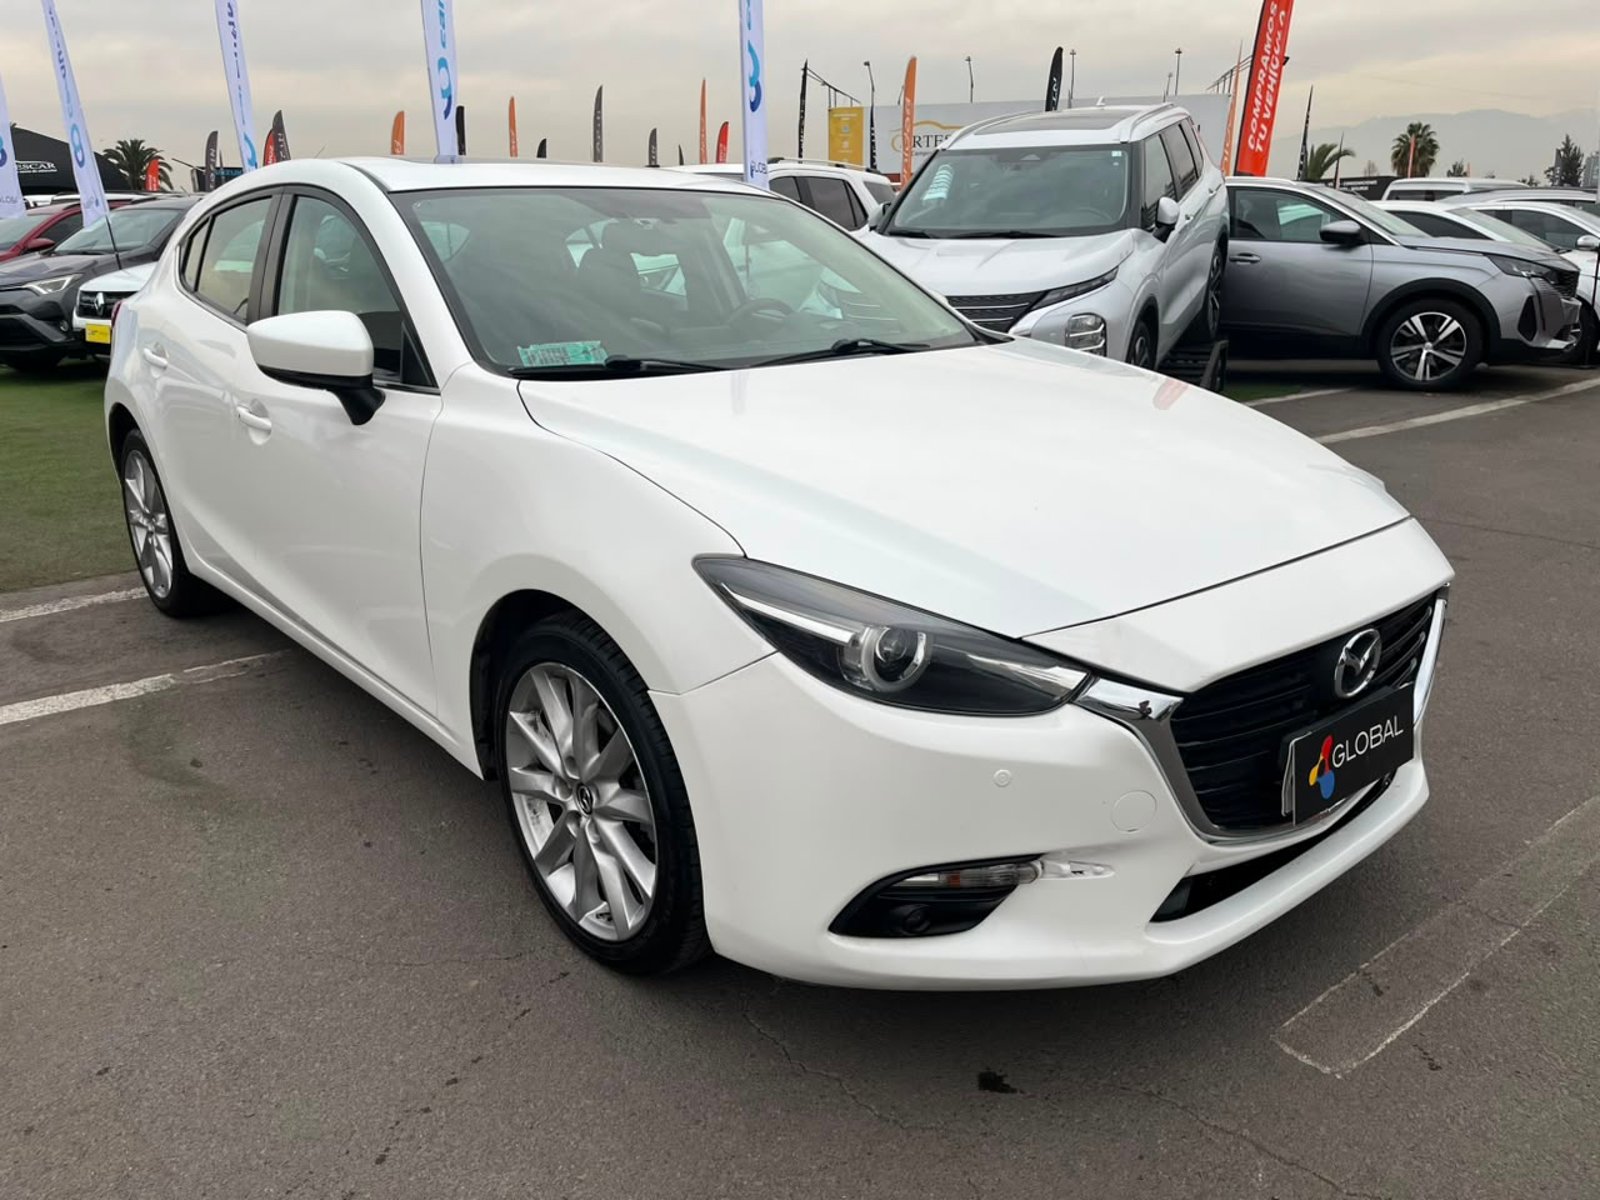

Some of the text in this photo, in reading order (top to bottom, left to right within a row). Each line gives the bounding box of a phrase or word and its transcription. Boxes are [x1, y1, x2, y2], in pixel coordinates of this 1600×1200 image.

[1248, 1, 1278, 150] COMPRAMOS
[1255, 124, 1268, 153] TU
[1332, 714, 1404, 768] GLOBAL
